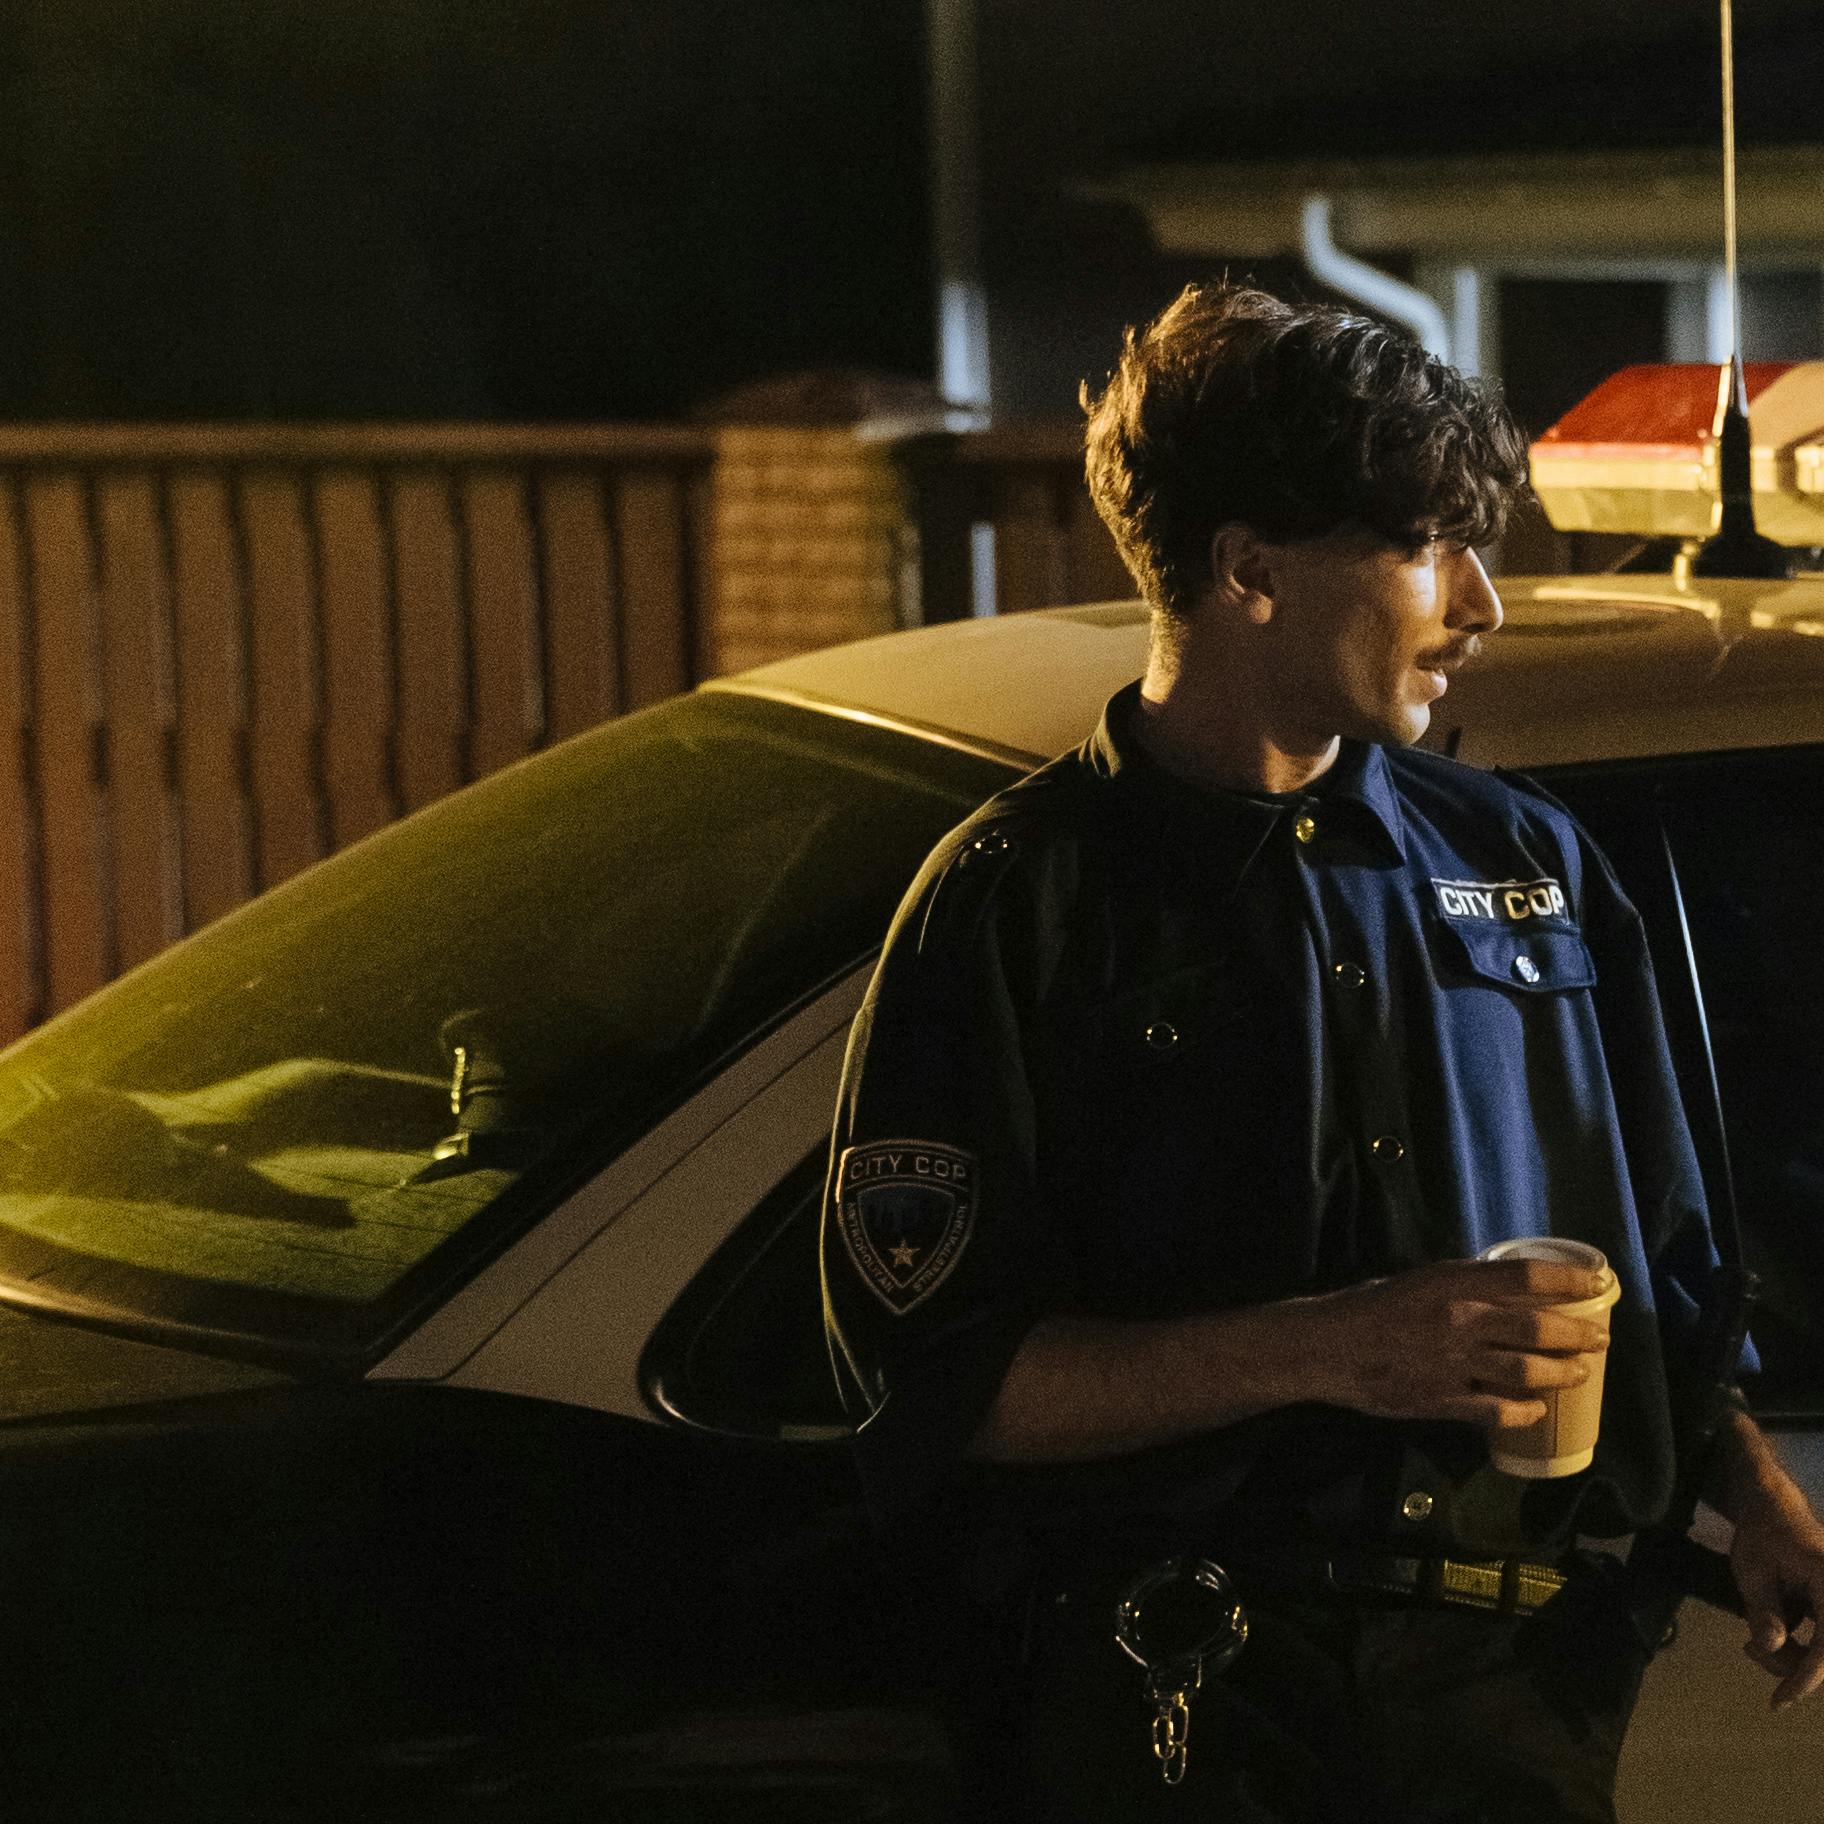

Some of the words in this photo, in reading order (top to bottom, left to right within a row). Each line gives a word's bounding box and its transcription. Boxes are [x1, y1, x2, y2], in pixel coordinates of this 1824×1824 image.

[1439, 887, 1495, 919] CITY
[1504, 885, 1565, 920] COP
[850, 1154, 902, 1180] CITY
[915, 1156, 966, 1180] COP
